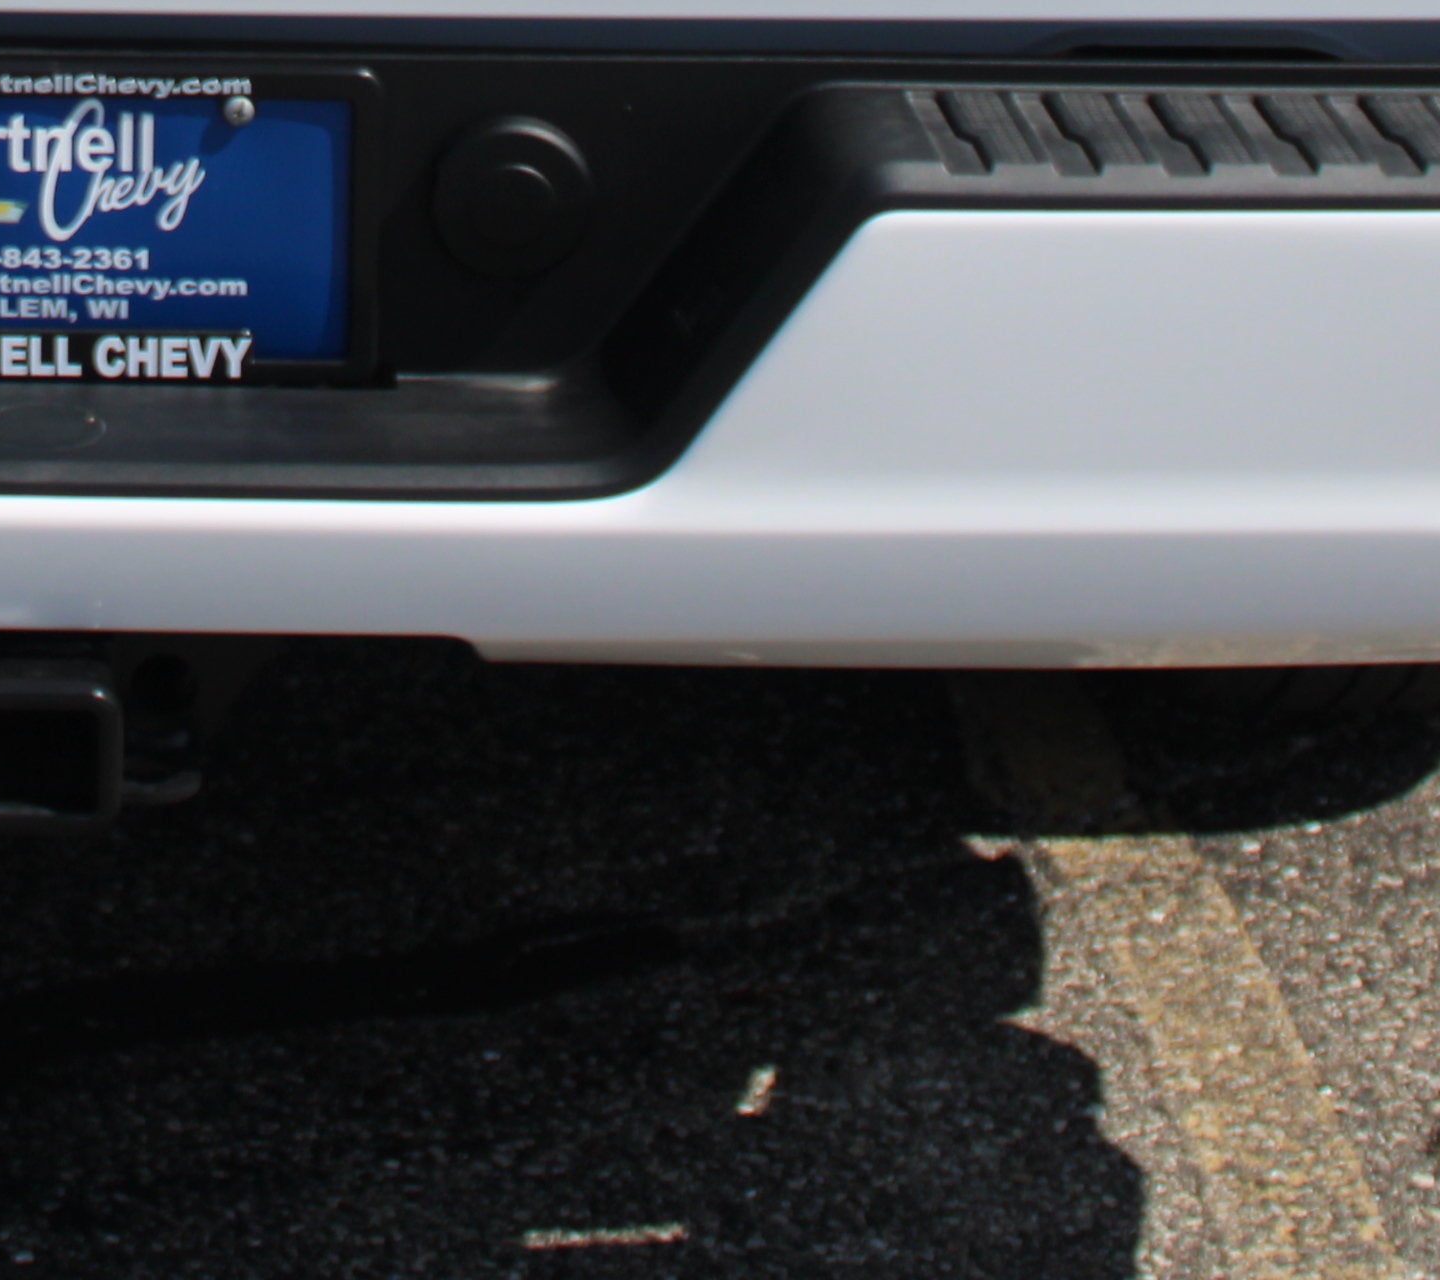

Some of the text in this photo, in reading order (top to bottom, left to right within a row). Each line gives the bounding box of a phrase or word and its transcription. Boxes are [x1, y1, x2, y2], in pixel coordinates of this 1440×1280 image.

[39, 98, 206, 241] Chevy
[87, 297, 130, 320] WI
[93, 334, 252, 379] CHEVY
